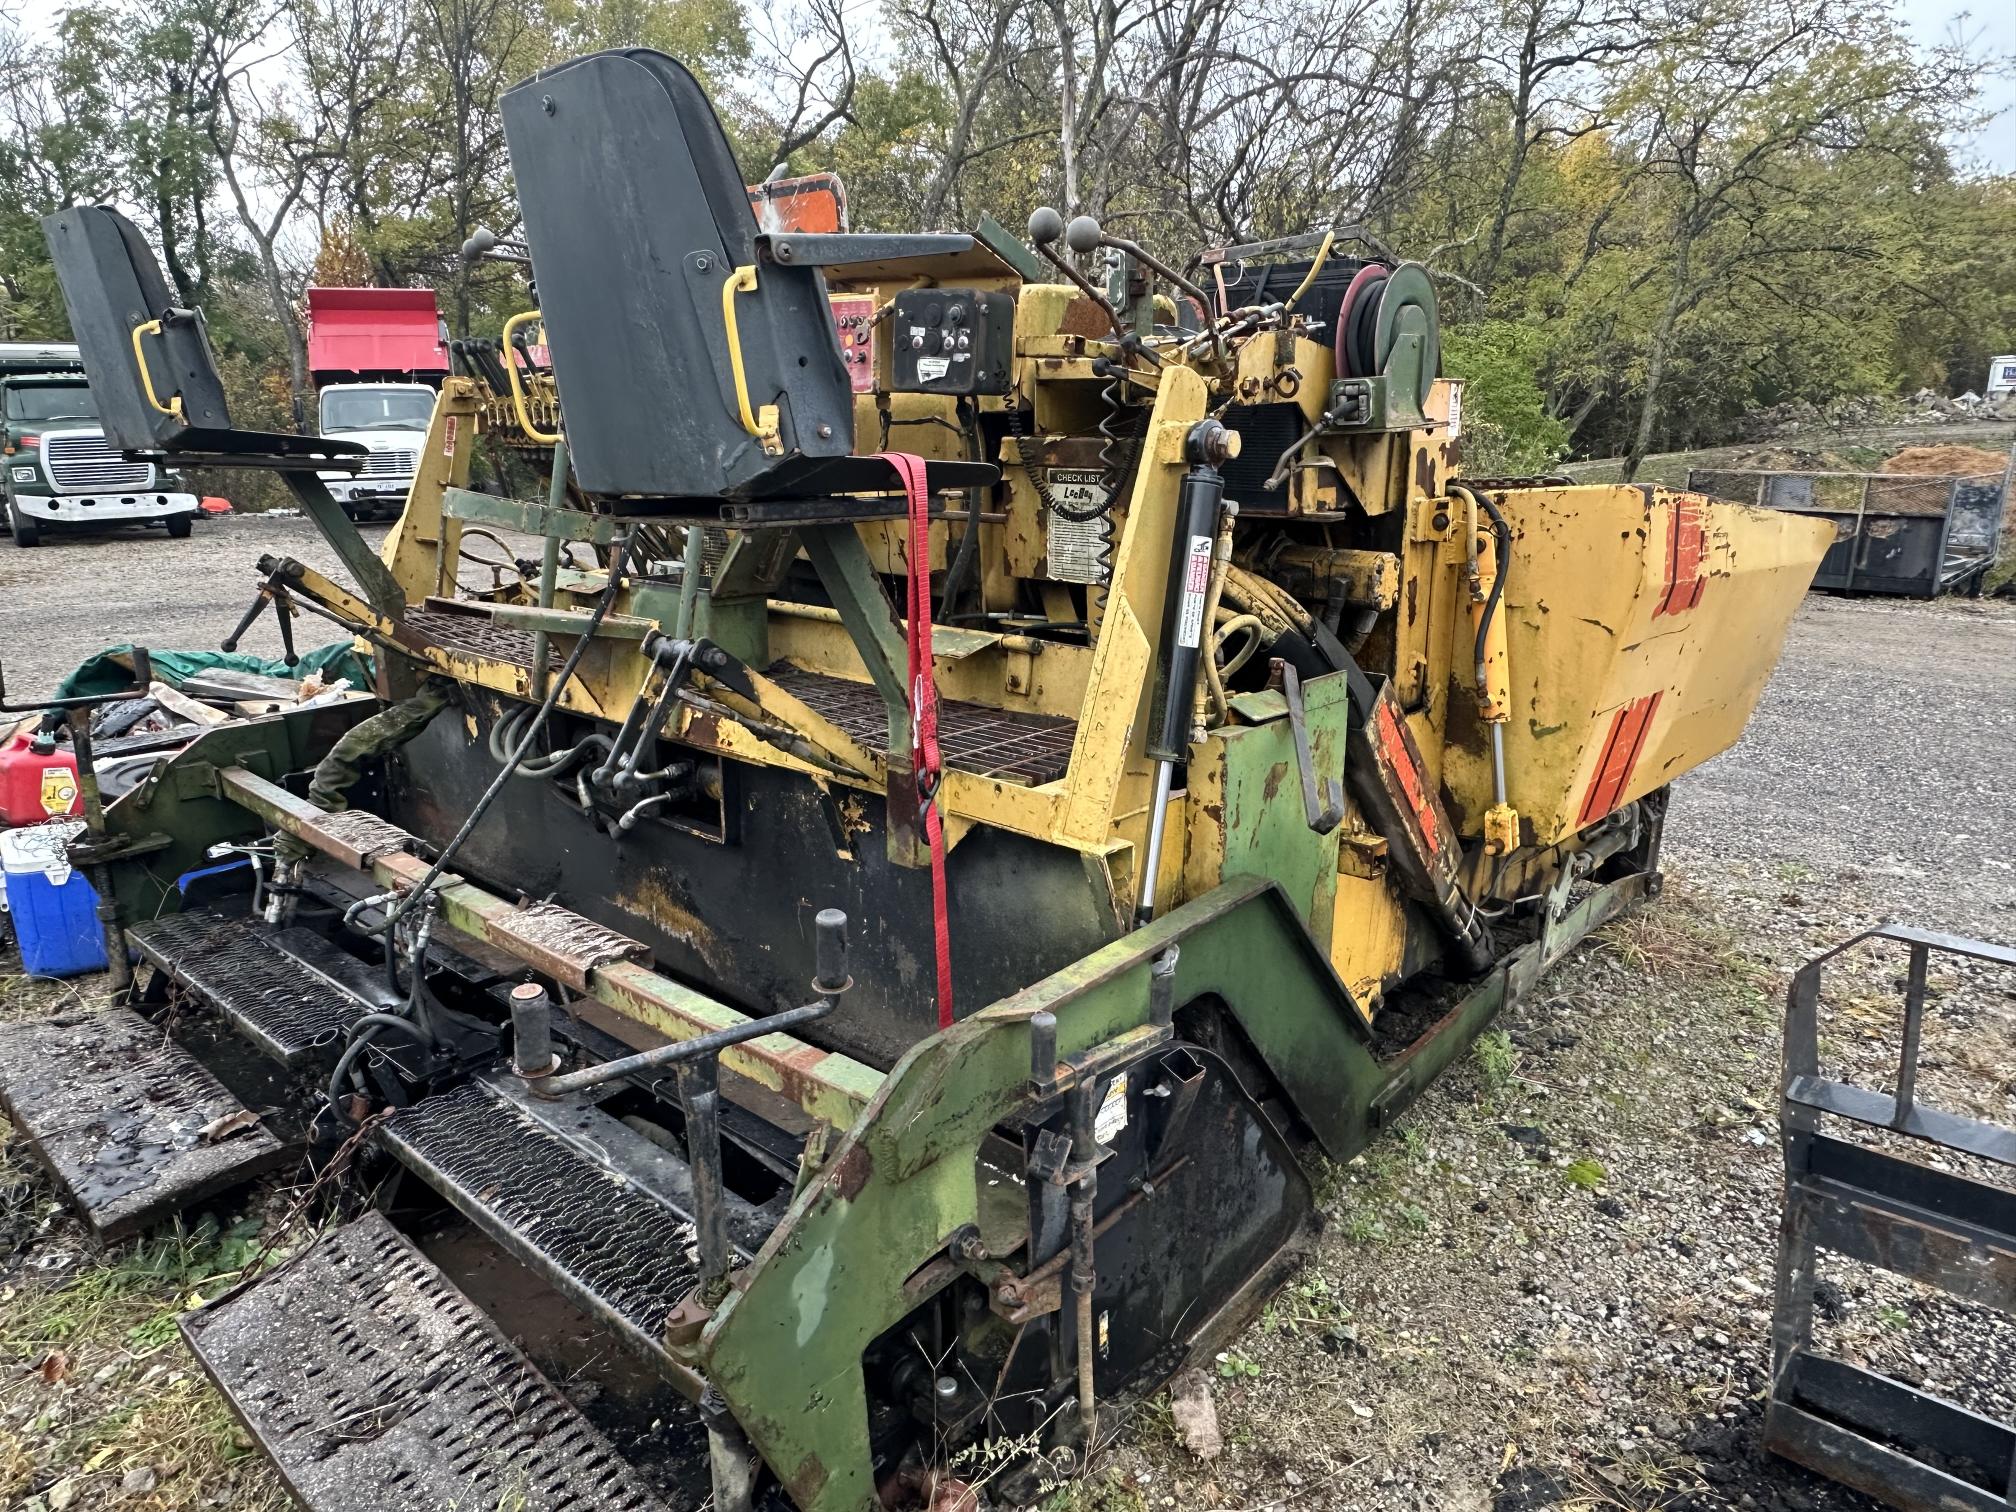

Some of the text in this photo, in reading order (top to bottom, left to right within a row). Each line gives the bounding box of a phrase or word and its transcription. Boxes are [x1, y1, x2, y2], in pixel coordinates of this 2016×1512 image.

[1057, 473, 1100, 483] CHECK LIST
[1064, 486, 1093, 503] LeeBoy
